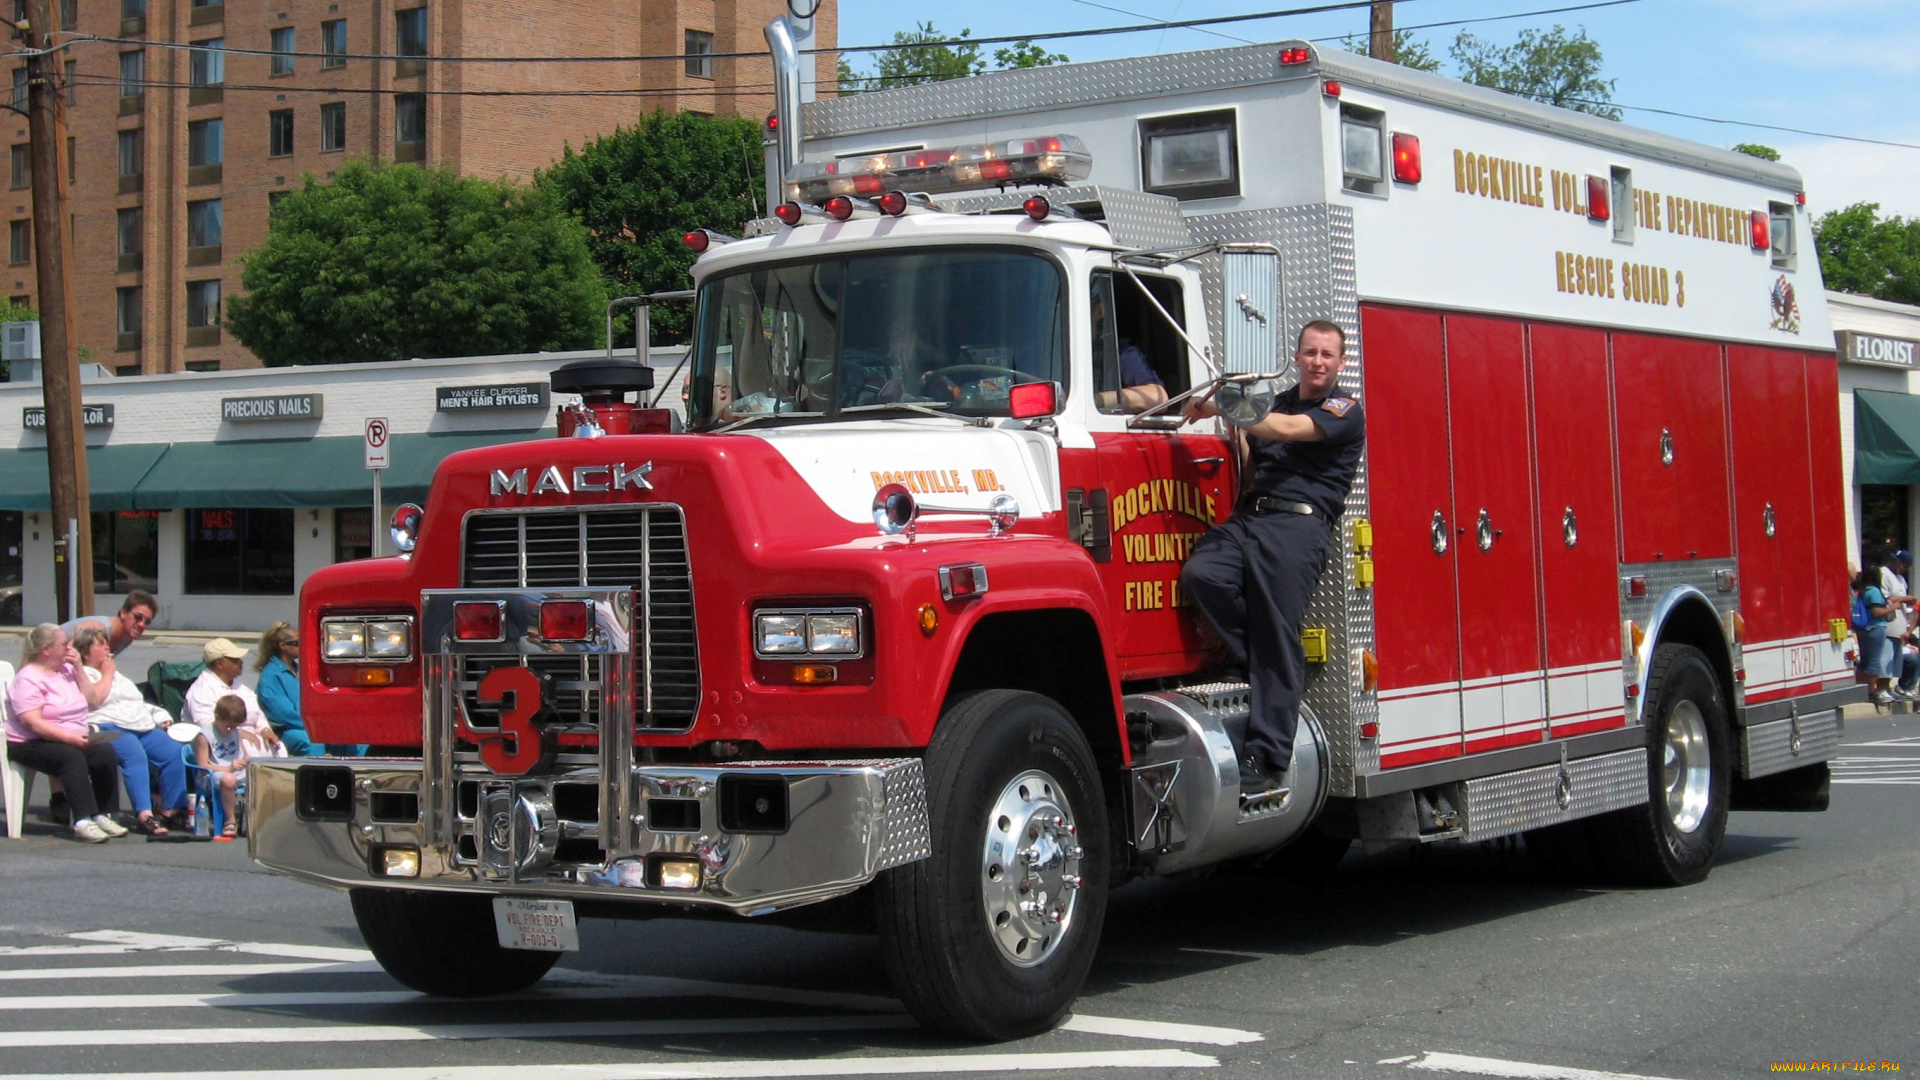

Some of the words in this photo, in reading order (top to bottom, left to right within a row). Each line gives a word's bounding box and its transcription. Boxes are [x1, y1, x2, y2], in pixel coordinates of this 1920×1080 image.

[1453, 149, 1544, 208] ROCKVILLE
[1632, 188, 1661, 231] FIRE
[1666, 195, 1749, 246] DEPARTMENT
[1555, 250, 1615, 299] RESCUE
[1621, 261, 1669, 306] SQUAD
[1675, 269, 1685, 308] 3
[1856, 335, 1914, 364] FLORIST
[440, 397, 468, 408] MEN'S
[471, 396, 494, 407] HAIR
[496, 394, 539, 406] STYLISTS
[450, 389, 486, 397] YANKEE
[490, 387, 528, 396] CLIPPER
[224, 399, 275, 417] PRECIOUS
[278, 398, 311, 414] NAILS
[490, 460, 654, 496] MACK
[972, 469, 1005, 492] MD.
[202, 510, 234, 529] NAILS
[1112, 479, 1217, 532] ROCKVILLE
[1122, 532, 1205, 563] VOLUNTE
[1125, 581, 1163, 611] FIRE
[1790, 646, 1816, 677] RVFD
[477, 666, 542, 775] 3
[543, 914, 564, 927] DEPT
